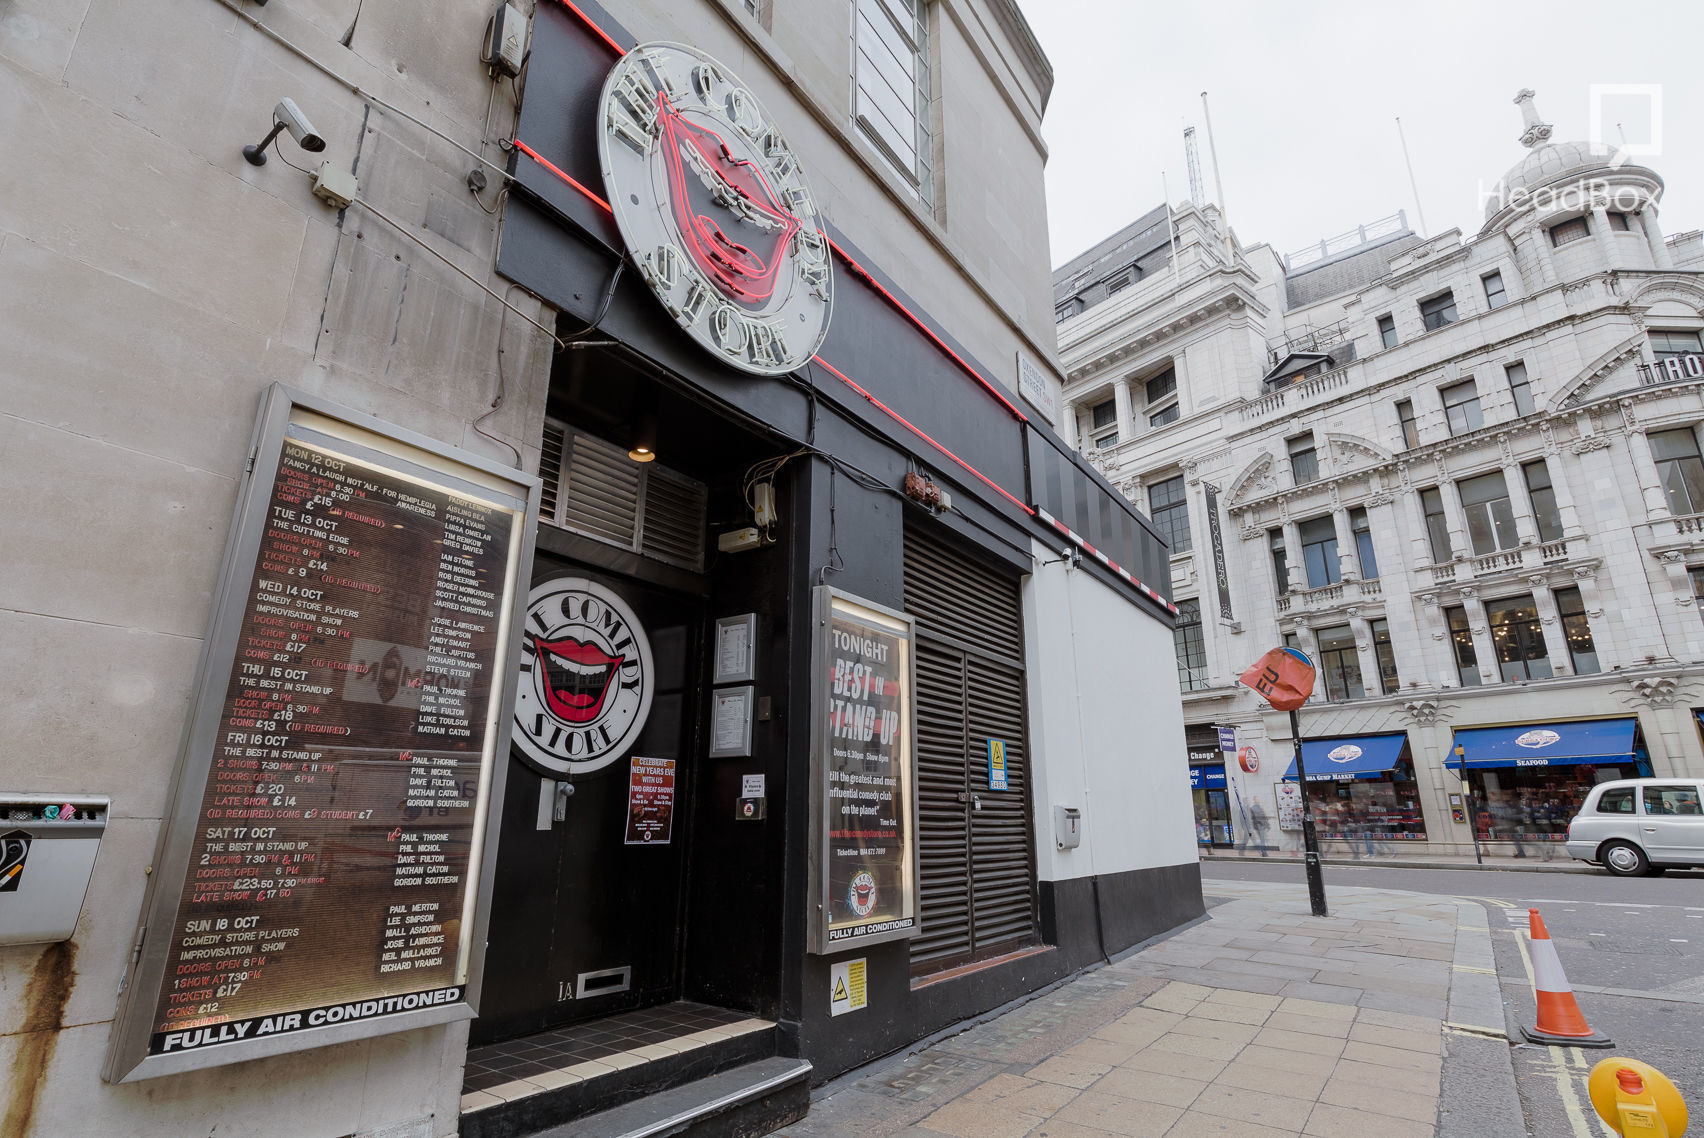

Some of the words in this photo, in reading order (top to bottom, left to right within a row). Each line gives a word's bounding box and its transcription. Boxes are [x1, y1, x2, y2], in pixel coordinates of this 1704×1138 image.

[691, 62, 830, 302] COMEDY
[646, 242, 799, 367] STORE
[285, 446, 309, 459] MON
[311, 453, 322, 465] 12
[325, 459, 346, 471] OCT
[283, 457, 310, 471] FANCY
[319, 469, 345, 482] LAUGH
[347, 477, 362, 487] NOT
[382, 488, 397, 498] FOR
[398, 494, 437, 510] HEMIPLEGIA
[396, 501, 436, 517] AWARENESS
[274, 506, 296, 520] TUE
[300, 513, 312, 524] 13
[316, 518, 338, 531] OCT
[272, 519, 289, 530] THE
[292, 525, 327, 539] CUTTING
[329, 534, 349, 545] EDGE
[1209, 507, 1227, 588] TROCADERO
[259, 579, 282, 592] WED
[286, 585, 298, 596] 14
[301, 588, 324, 600] OCT
[257, 592, 292, 605] COMEDY
[296, 600, 322, 612] STORE
[325, 606, 359, 618] PLAYERS
[435, 590, 456, 600] SCOTT
[458, 595, 487, 607] CAPURRO
[256, 604, 316, 621] IMPROVISATION
[321, 616, 343, 626] SHOW
[433, 600, 459, 611] JARRED
[460, 605, 494, 617] CHRISTMAS
[561, 596, 640, 696] COMEDY
[832, 629, 888, 662] TONIGHT
[242, 663, 264, 675] THU
[270, 667, 282, 678] 15
[284, 670, 308, 681] OCT
[834, 658, 872, 701] BEST
[874, 675, 885, 696] IN
[240, 677, 257, 686] THE
[260, 680, 282, 689] BEST
[295, 684, 321, 694] STAND
[273, 710, 294, 721] £18
[418, 715, 437, 724] LUKE
[438, 717, 469, 727] TOULSON
[256, 720, 276, 731] £13
[880, 709, 898, 745] UP
[227, 732, 246, 744] FRI
[250, 734, 262, 744] 16
[264, 736, 288, 746] OCT
[528, 713, 618, 756] STORE
[224, 746, 243, 756] THE
[246, 748, 268, 757] BEST
[282, 751, 309, 760] STAND
[311, 752, 322, 760] UP
[834, 748, 846, 757] Doors
[432, 758, 458, 766] THORNE
[840, 772, 849, 782] the
[850, 774, 872, 784] greatest
[873, 776, 884, 785] and
[884, 778, 896, 786] most
[859, 790, 879, 802] comedy
[880, 791, 892, 800] club
[842, 806, 850, 814] on
[851, 804, 859, 814] the
[206, 828, 231, 838] SAT
[233, 828, 247, 838] 17
[250, 828, 276, 838] OCT
[206, 843, 225, 852] THE
[228, 843, 253, 852] BEST
[256, 843, 264, 851] IN
[266, 842, 295, 851] STAND
[389, 905, 407, 914] PAUL
[412, 903, 439, 912] MERTON
[185, 920, 211, 933] SUN
[215, 919, 229, 931] 18
[234, 916, 260, 929] OCT
[387, 917, 401, 925] LEE
[405, 914, 434, 924] SIMPSON
[182, 934, 222, 947] COMEDY
[226, 932, 257, 943] STORE
[258, 928, 300, 940] PLAYERS
[385, 928, 406, 937] NIALL
[409, 924, 442, 935] ASHDOWN
[830, 926, 852, 940] FULLY
[854, 925, 866, 935] AIR
[867, 919, 913, 934] CONDITIONED
[384, 939, 405, 949] JOSIE
[409, 935, 445, 946] LAWRENCE
[180, 945, 253, 960] IMPROVISATION
[261, 942, 286, 952] SHOW
[382, 952, 397, 961] NEIL
[401, 946, 442, 959] MULLARKEY
[380, 961, 411, 973] RICHARD
[415, 958, 442, 968] VRANCH
[169, 990, 214, 1004] TICKETS
[216, 983, 242, 998] £17
[163, 1022, 252, 1051] FULLY
[256, 1014, 301, 1035] AIR
[308, 988, 460, 1026] CONDITIONED
